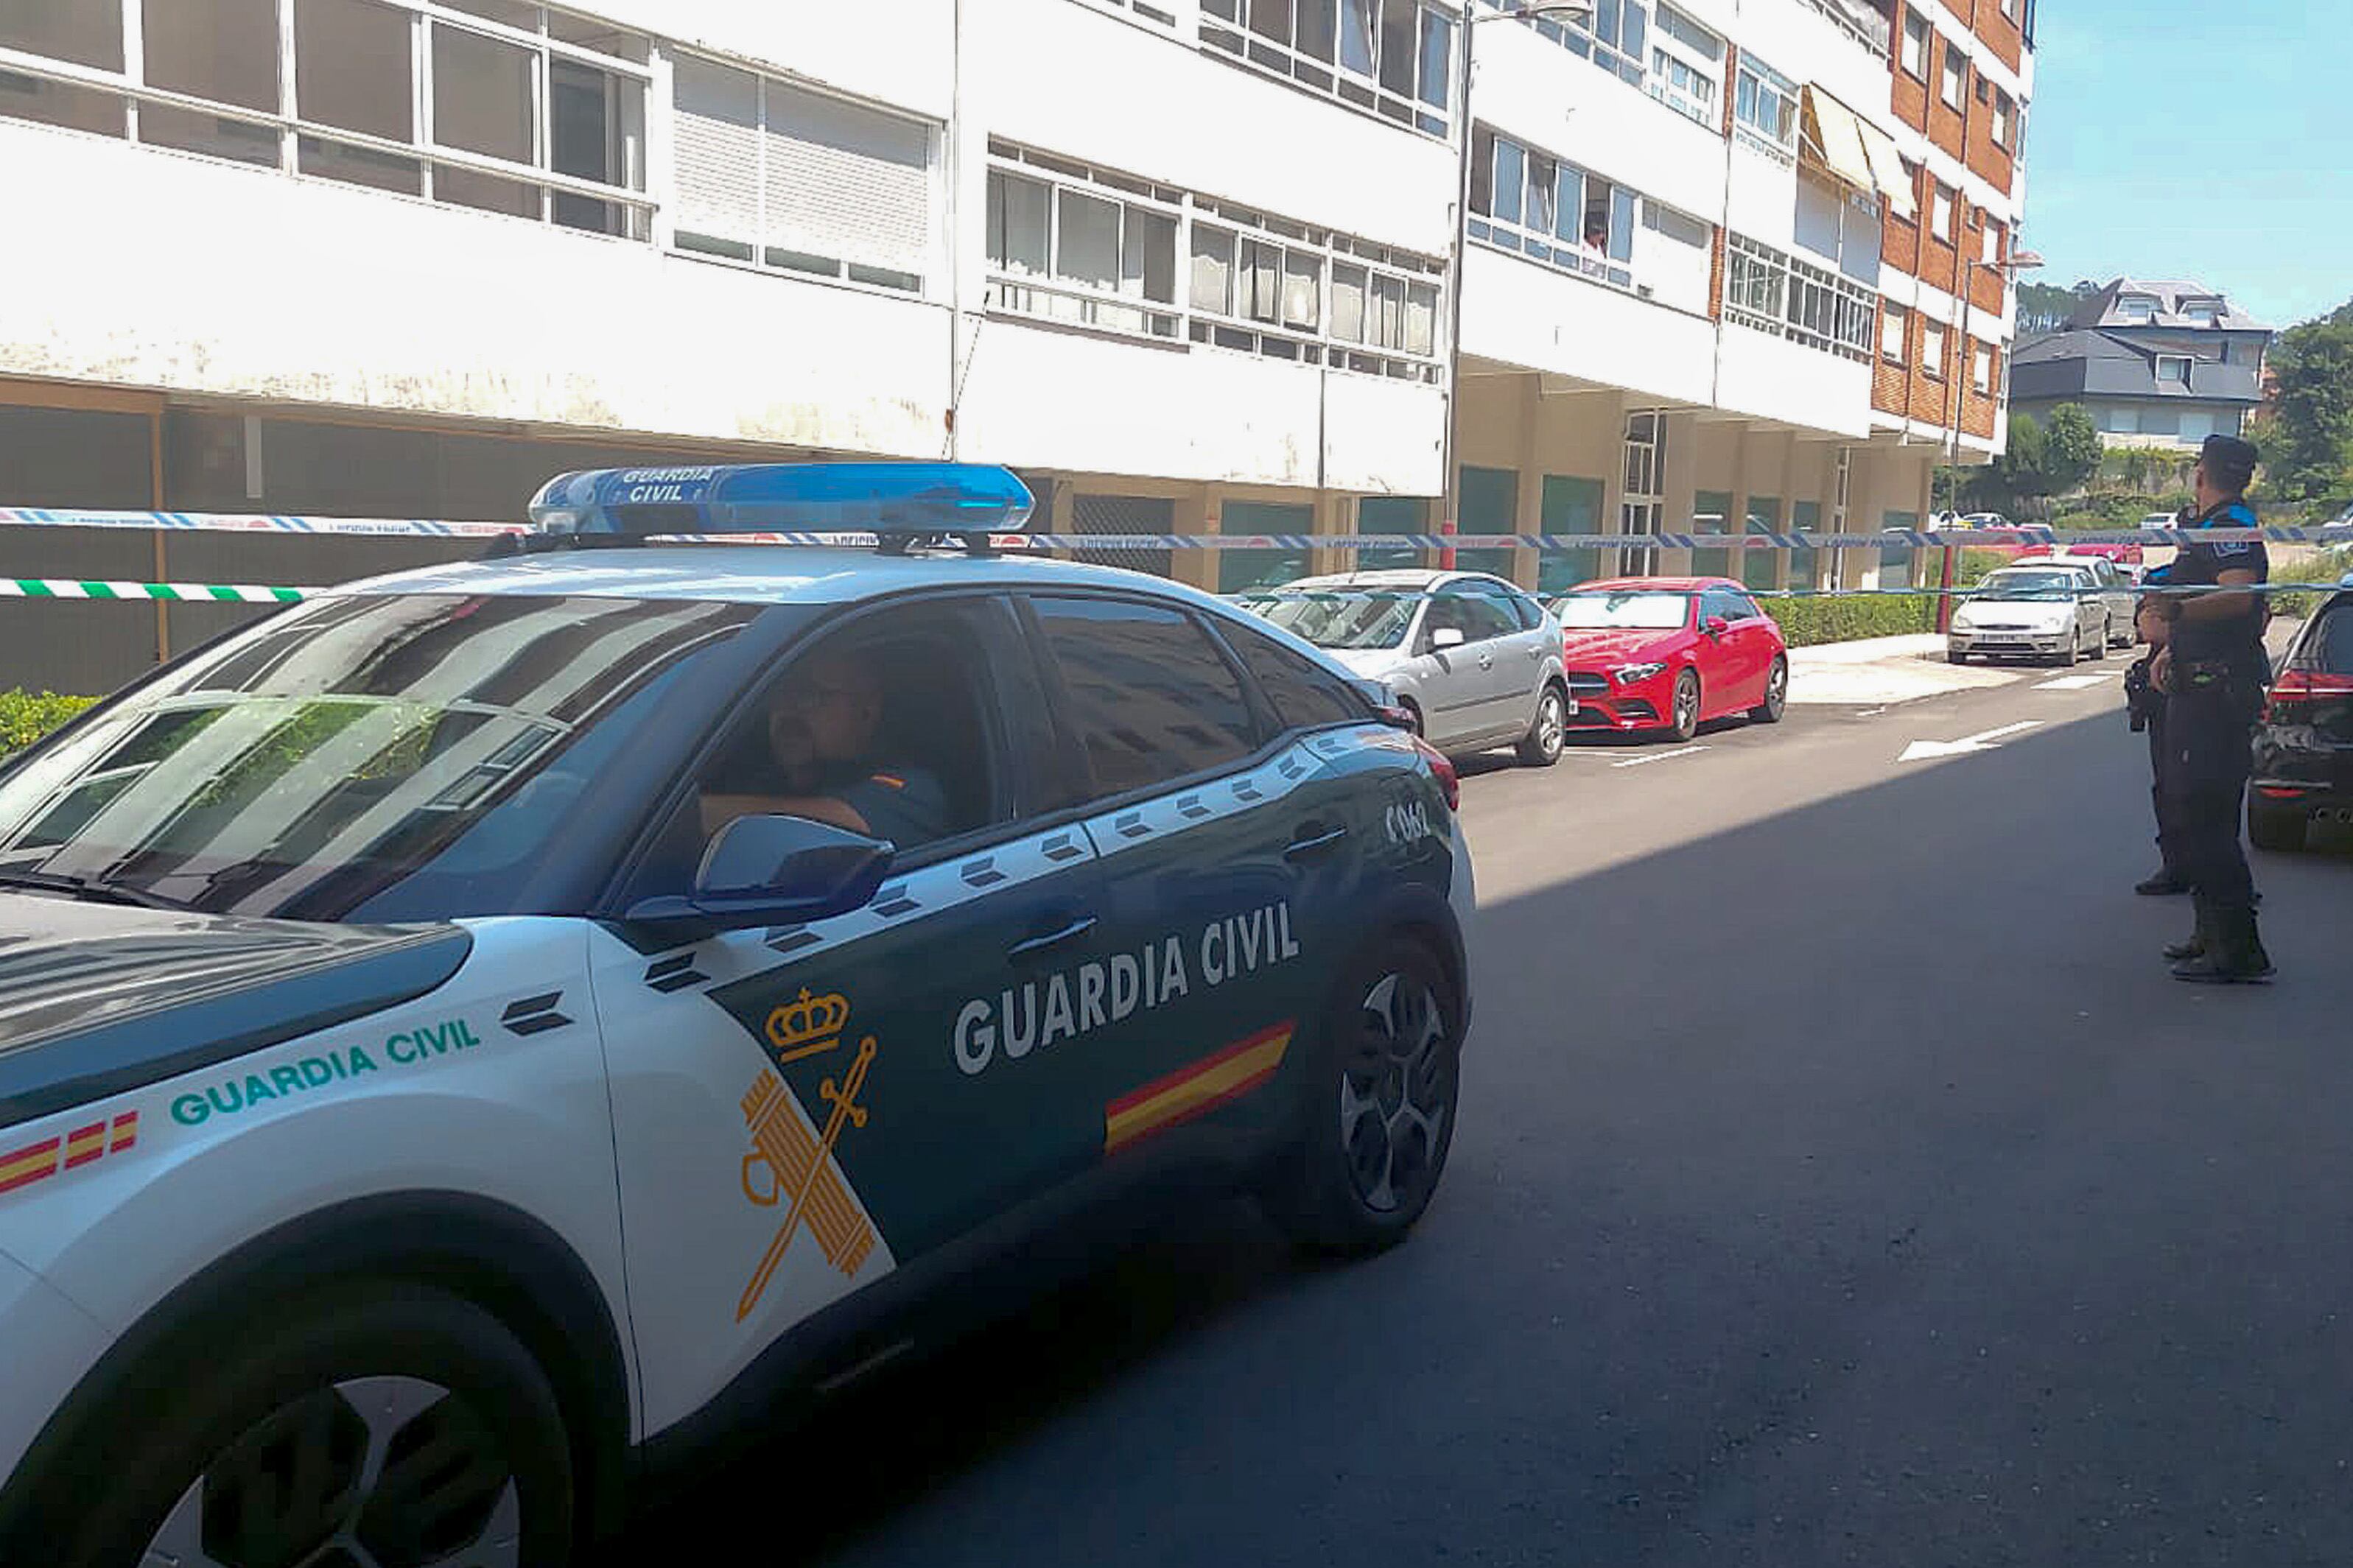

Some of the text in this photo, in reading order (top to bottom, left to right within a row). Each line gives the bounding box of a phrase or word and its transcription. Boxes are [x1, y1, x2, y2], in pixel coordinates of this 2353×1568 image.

[623, 468, 714, 483] GUARDIA
[630, 485, 682, 502] CIVIL
[955, 901, 1300, 1075] GUARDIA CIVIL
[170, 1019, 480, 1126] GUARDIA CIVIL
